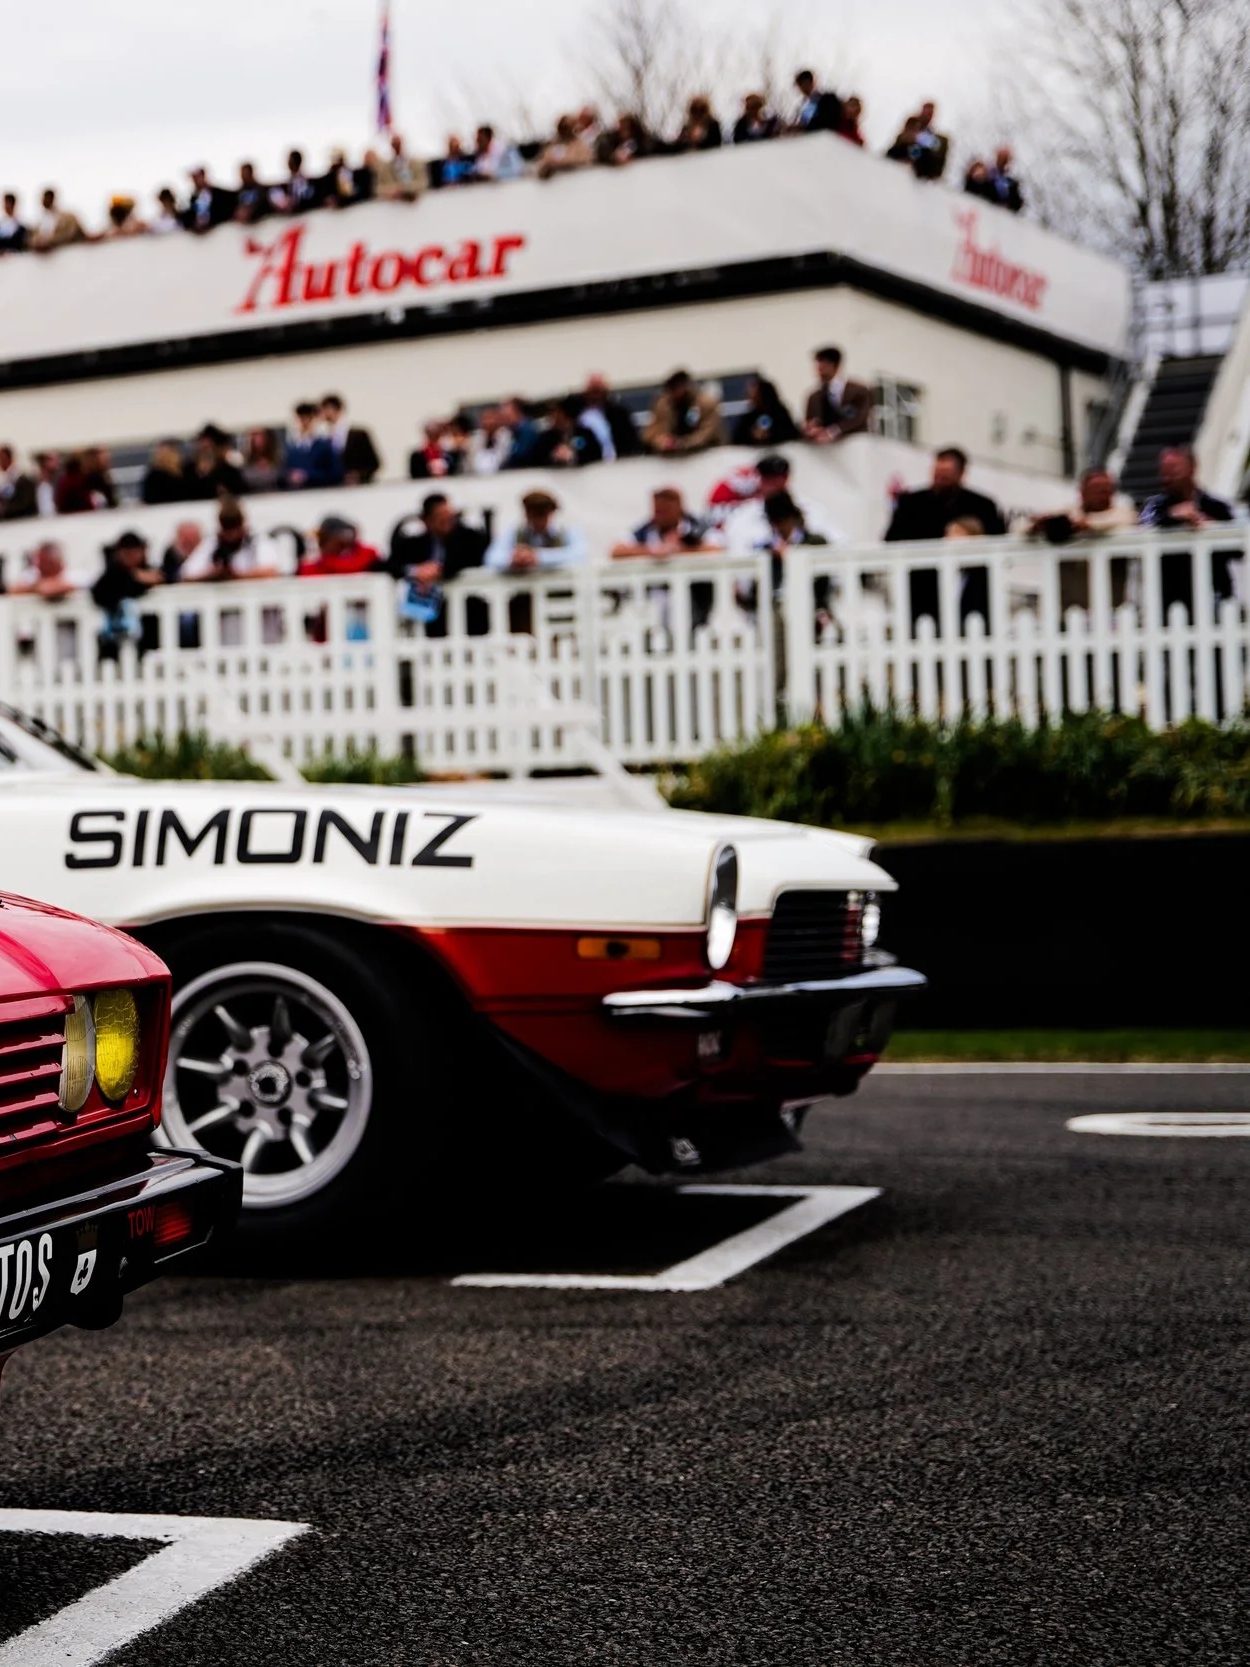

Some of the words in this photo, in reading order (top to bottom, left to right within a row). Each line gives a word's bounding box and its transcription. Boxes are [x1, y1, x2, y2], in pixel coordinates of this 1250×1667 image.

[235, 222, 526, 315] Autocar
[63, 807, 483, 870] SIMONIZ
[127, 1203, 156, 1242] TOW
